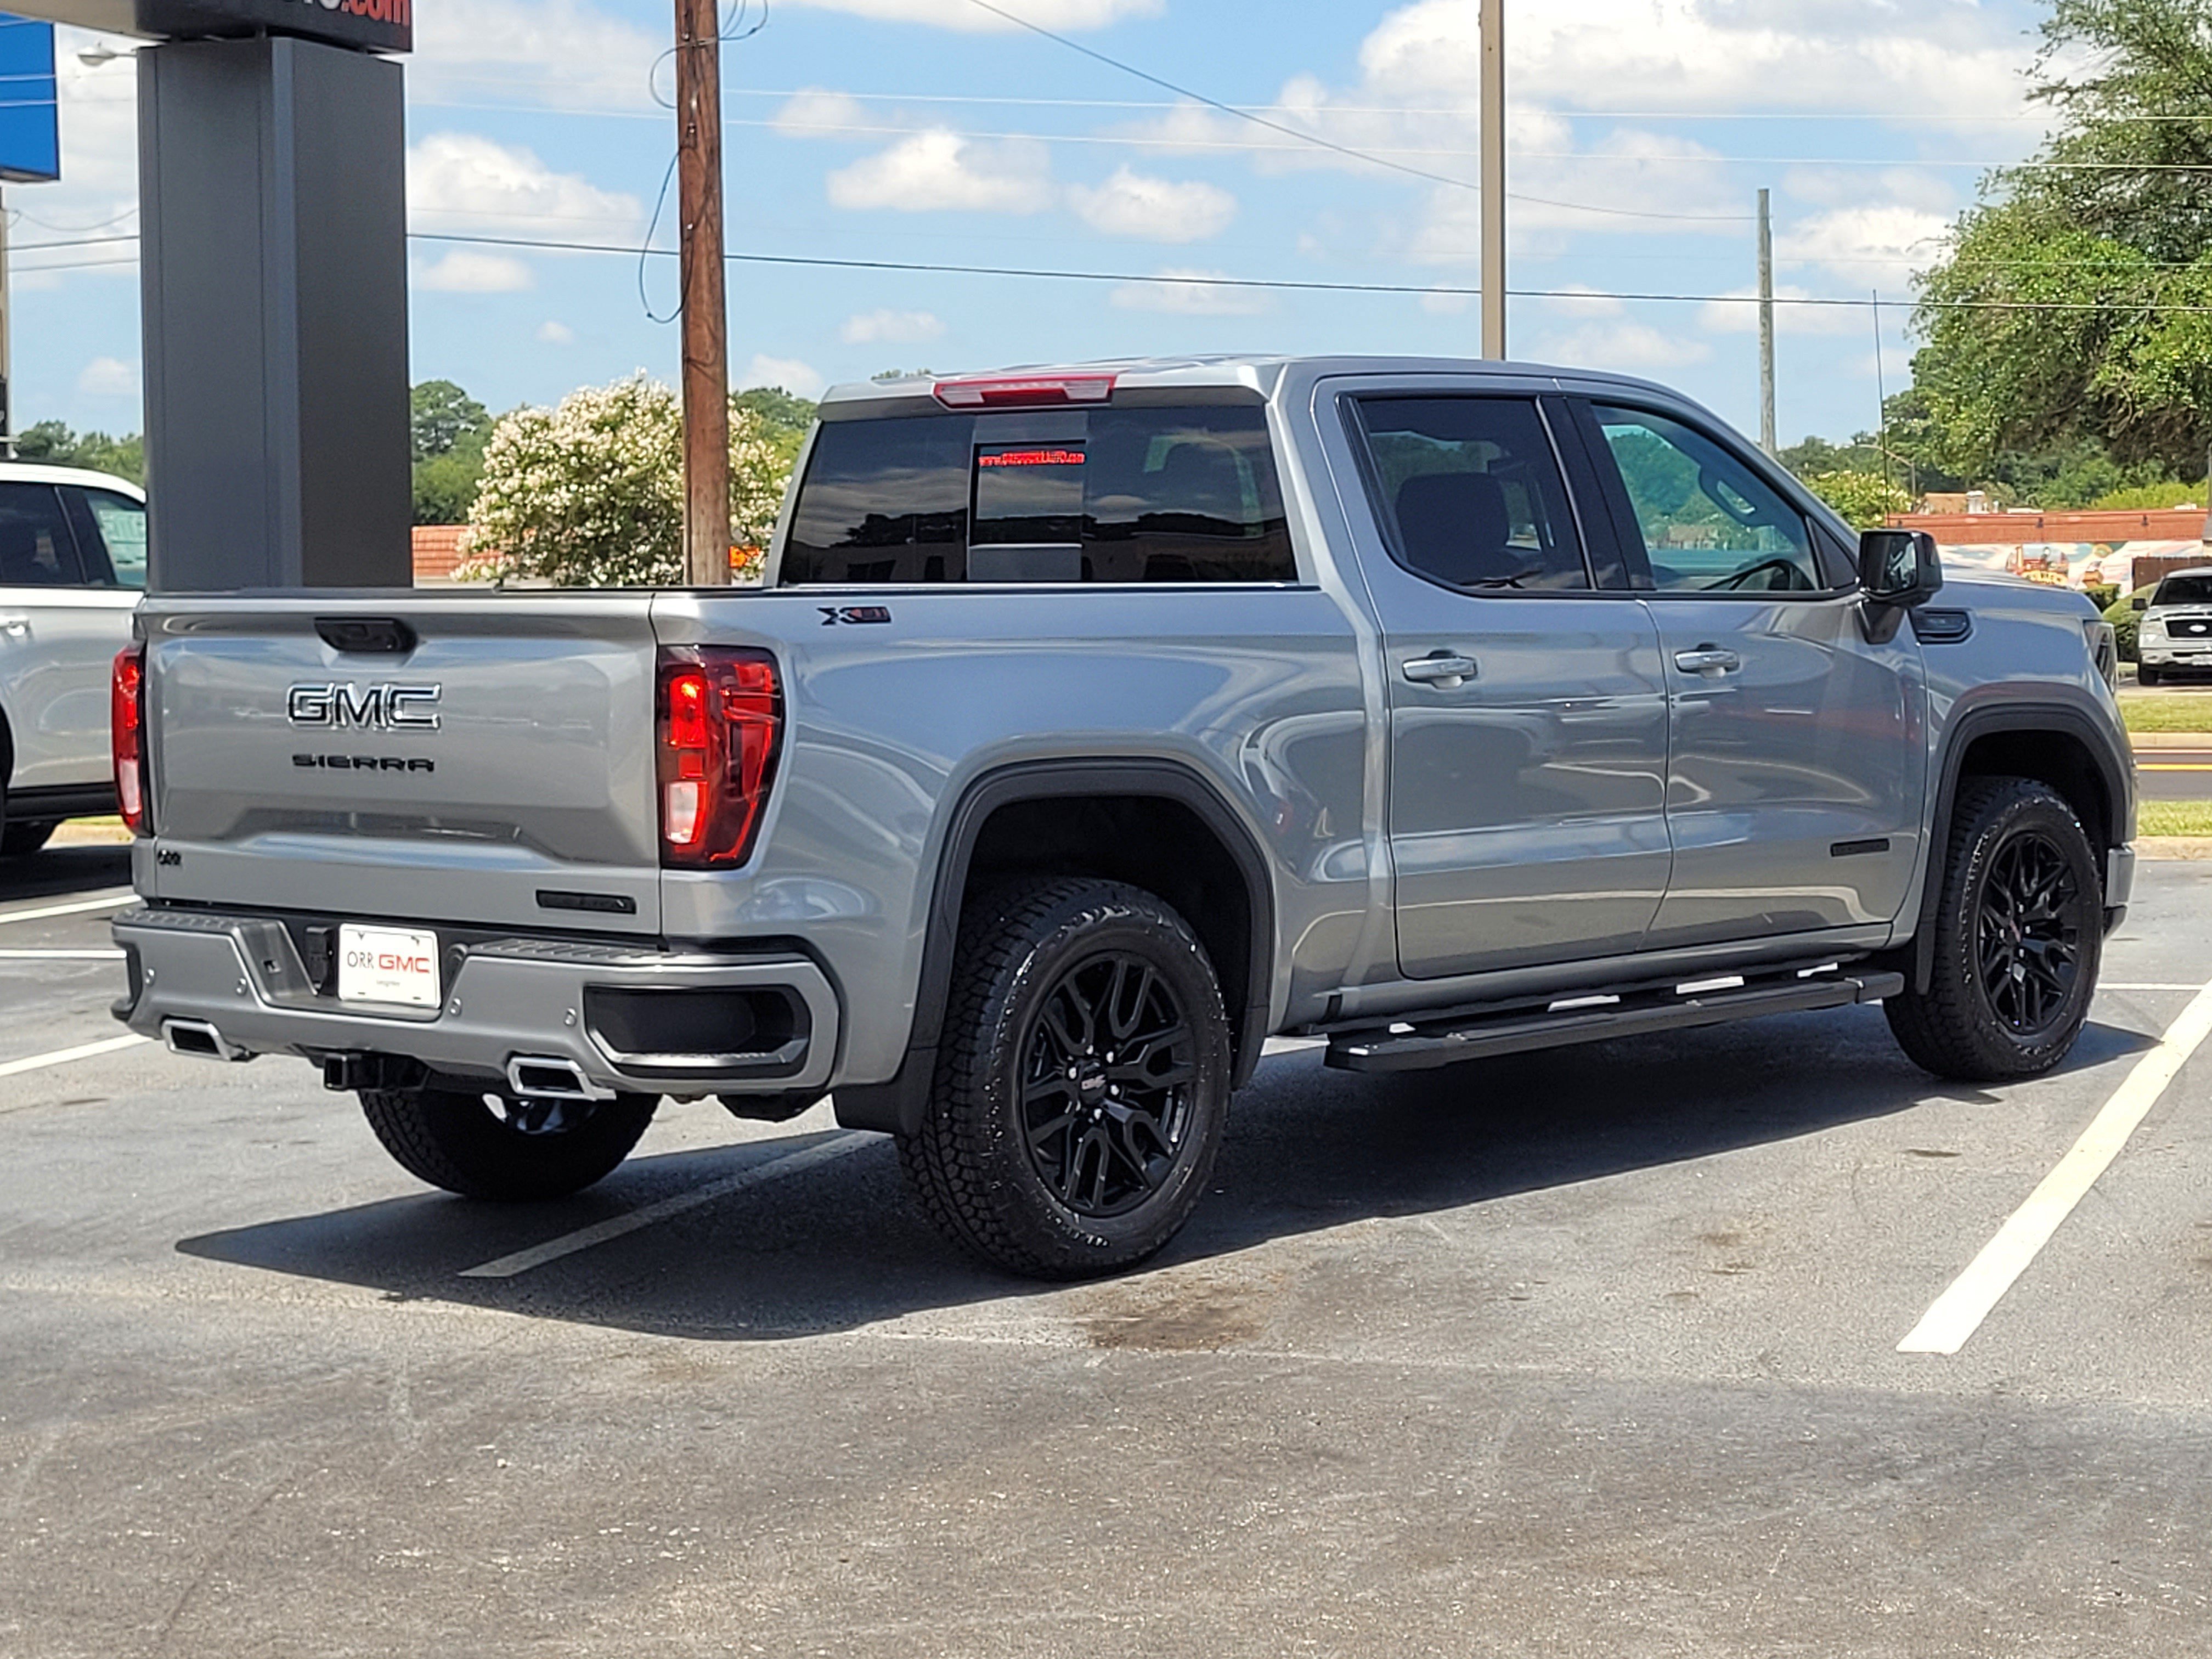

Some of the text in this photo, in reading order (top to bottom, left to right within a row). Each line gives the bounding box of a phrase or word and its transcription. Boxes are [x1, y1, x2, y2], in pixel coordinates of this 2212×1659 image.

[287, 683, 441, 729] GMC
[292, 754, 435, 772] SIERRA
[347, 950, 430, 974] ORR GMC
